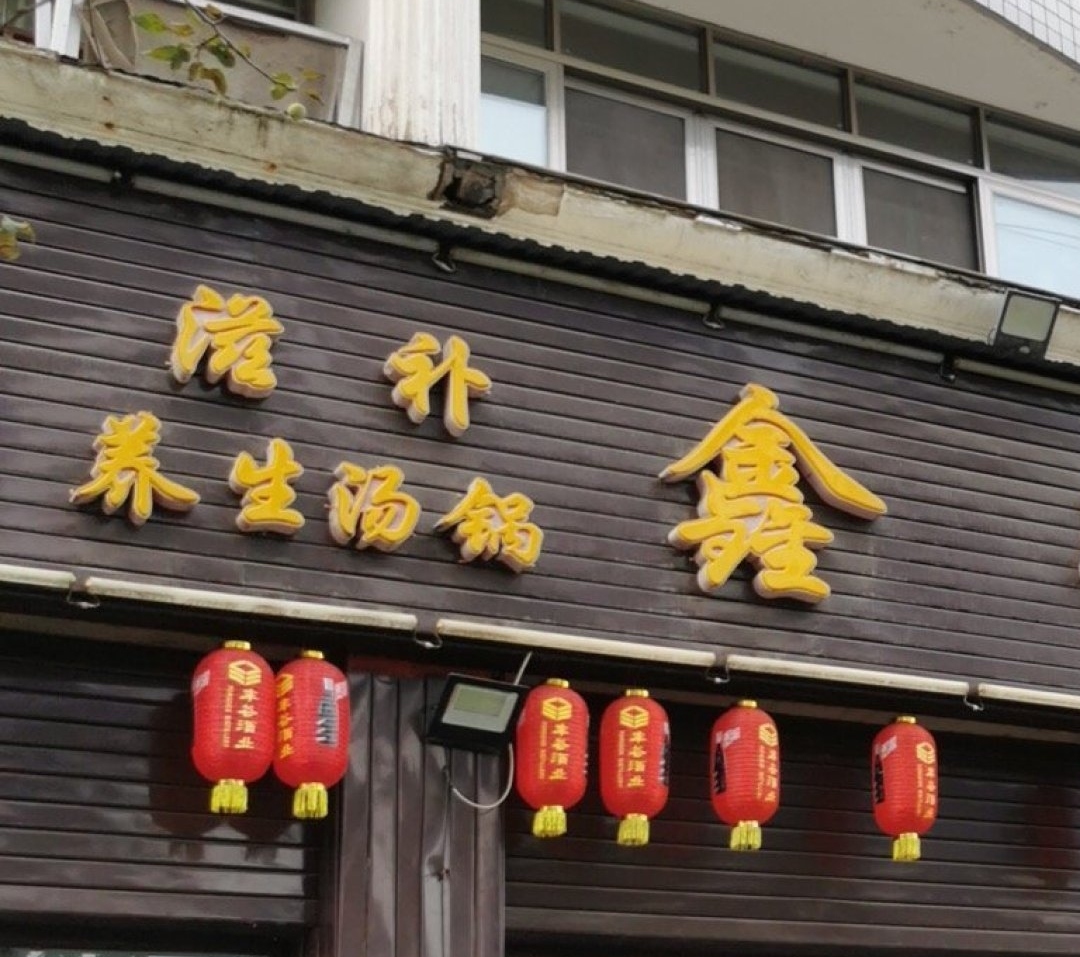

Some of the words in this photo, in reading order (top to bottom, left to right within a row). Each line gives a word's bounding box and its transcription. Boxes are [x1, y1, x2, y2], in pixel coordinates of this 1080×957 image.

[171, 284, 492, 438] 滋补
[69, 410, 545, 574] 养生汤锅
